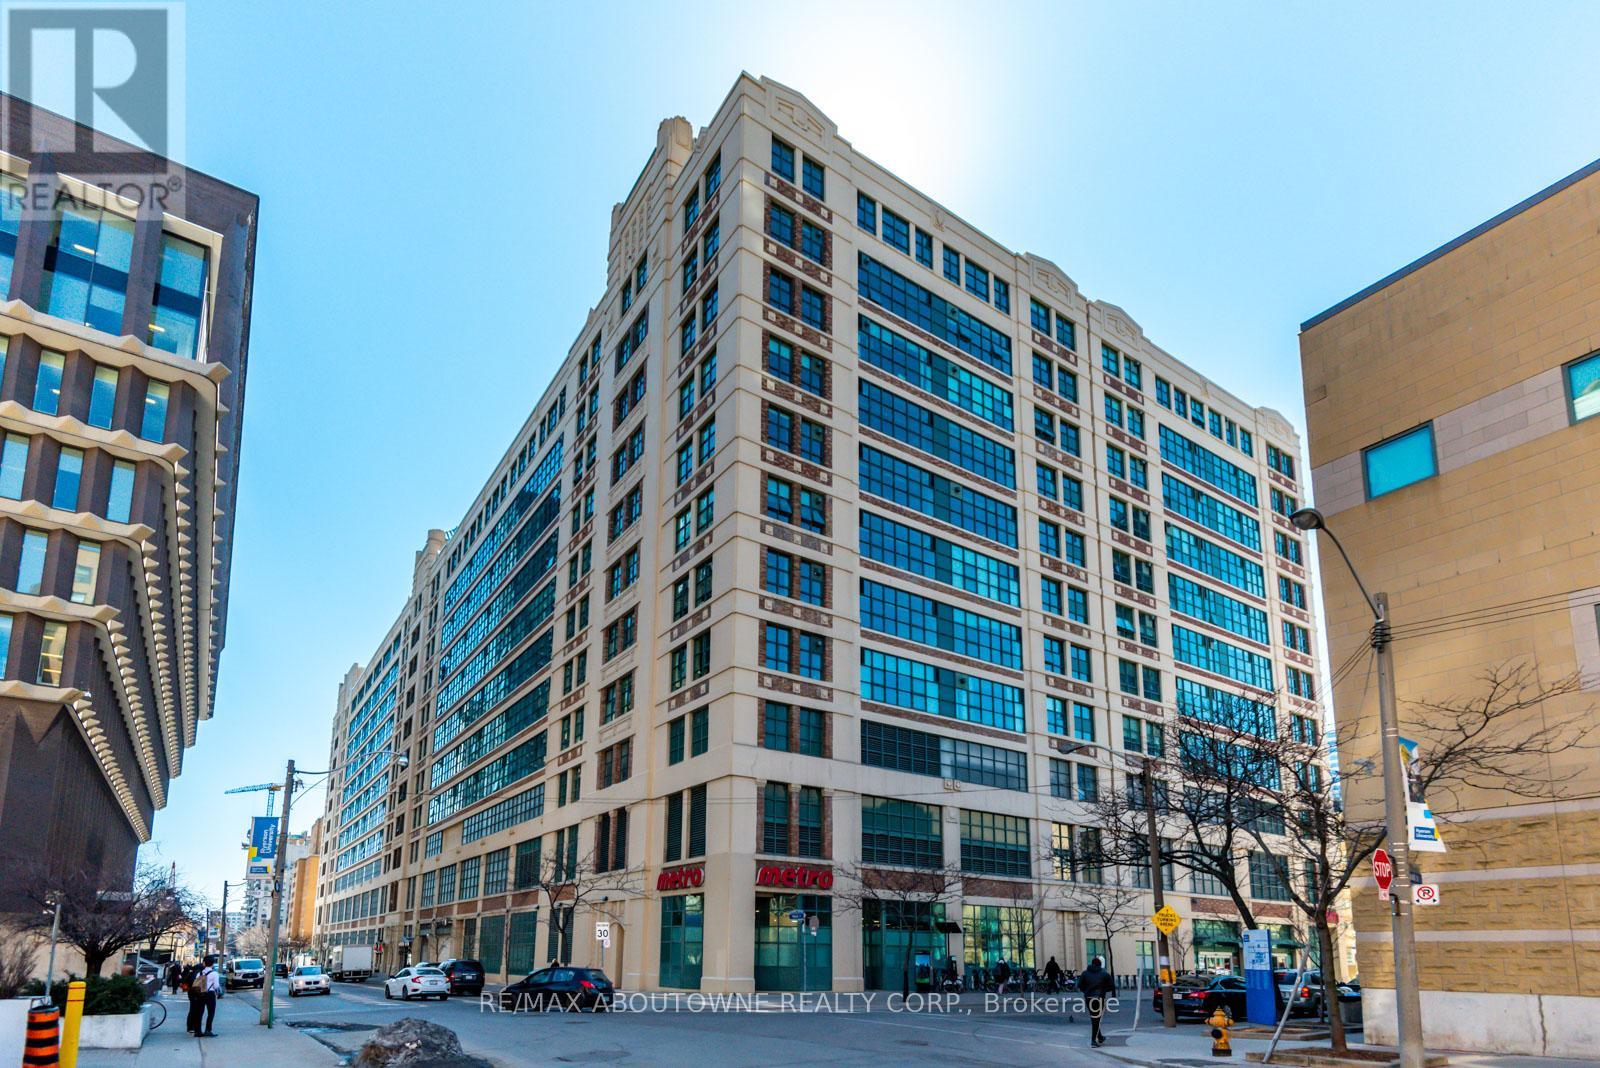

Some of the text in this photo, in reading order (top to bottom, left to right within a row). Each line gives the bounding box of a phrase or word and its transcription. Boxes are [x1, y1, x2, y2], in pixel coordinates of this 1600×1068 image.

[657, 863, 704, 891] metro
[756, 865, 833, 889] metro
[1374, 861, 1391, 878] STOP
[597, 929, 608, 938] 30
